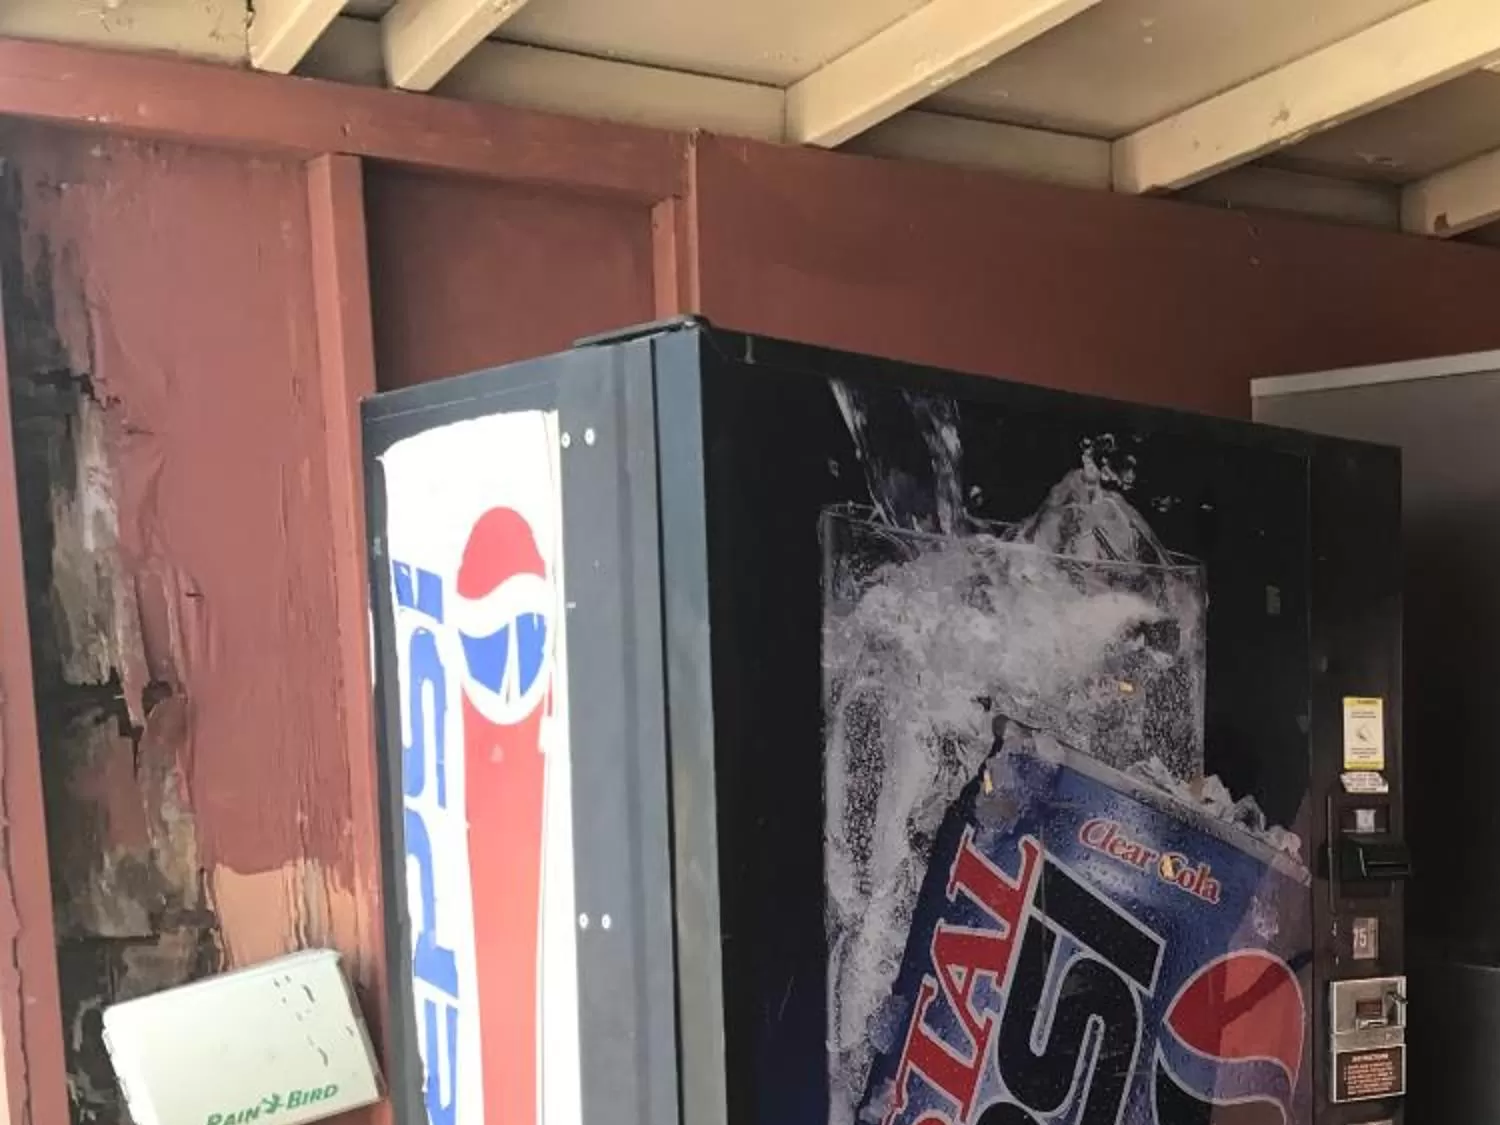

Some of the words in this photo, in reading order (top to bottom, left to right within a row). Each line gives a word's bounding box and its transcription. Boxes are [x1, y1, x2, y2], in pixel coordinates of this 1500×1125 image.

[1079, 818, 1161, 871] Clear
[1157, 852, 1221, 904] Cola
[286, 1084, 339, 1110] BIRD
